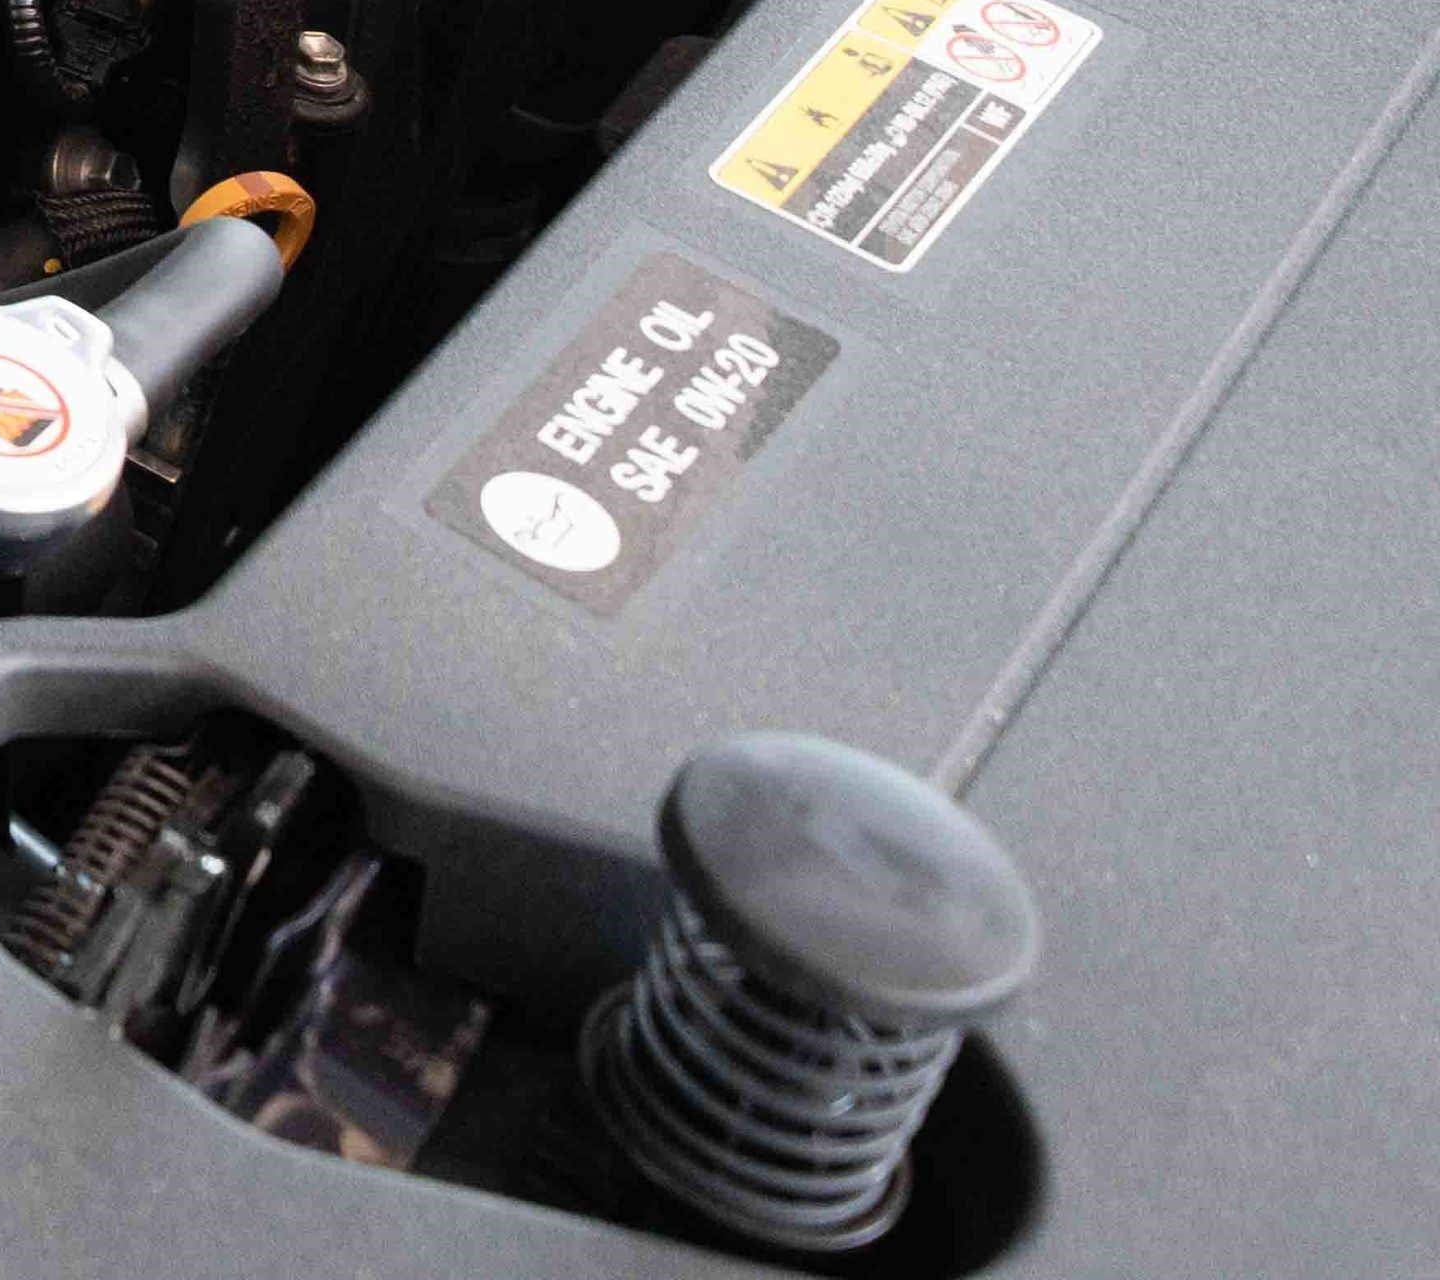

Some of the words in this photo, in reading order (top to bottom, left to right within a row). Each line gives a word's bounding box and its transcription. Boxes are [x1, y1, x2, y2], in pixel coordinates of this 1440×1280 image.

[537, 345, 663, 467] ENGINE
[638, 299, 716, 356] OIL
[609, 424, 700, 504] SAE
[676, 332, 781, 433] 0W-20
